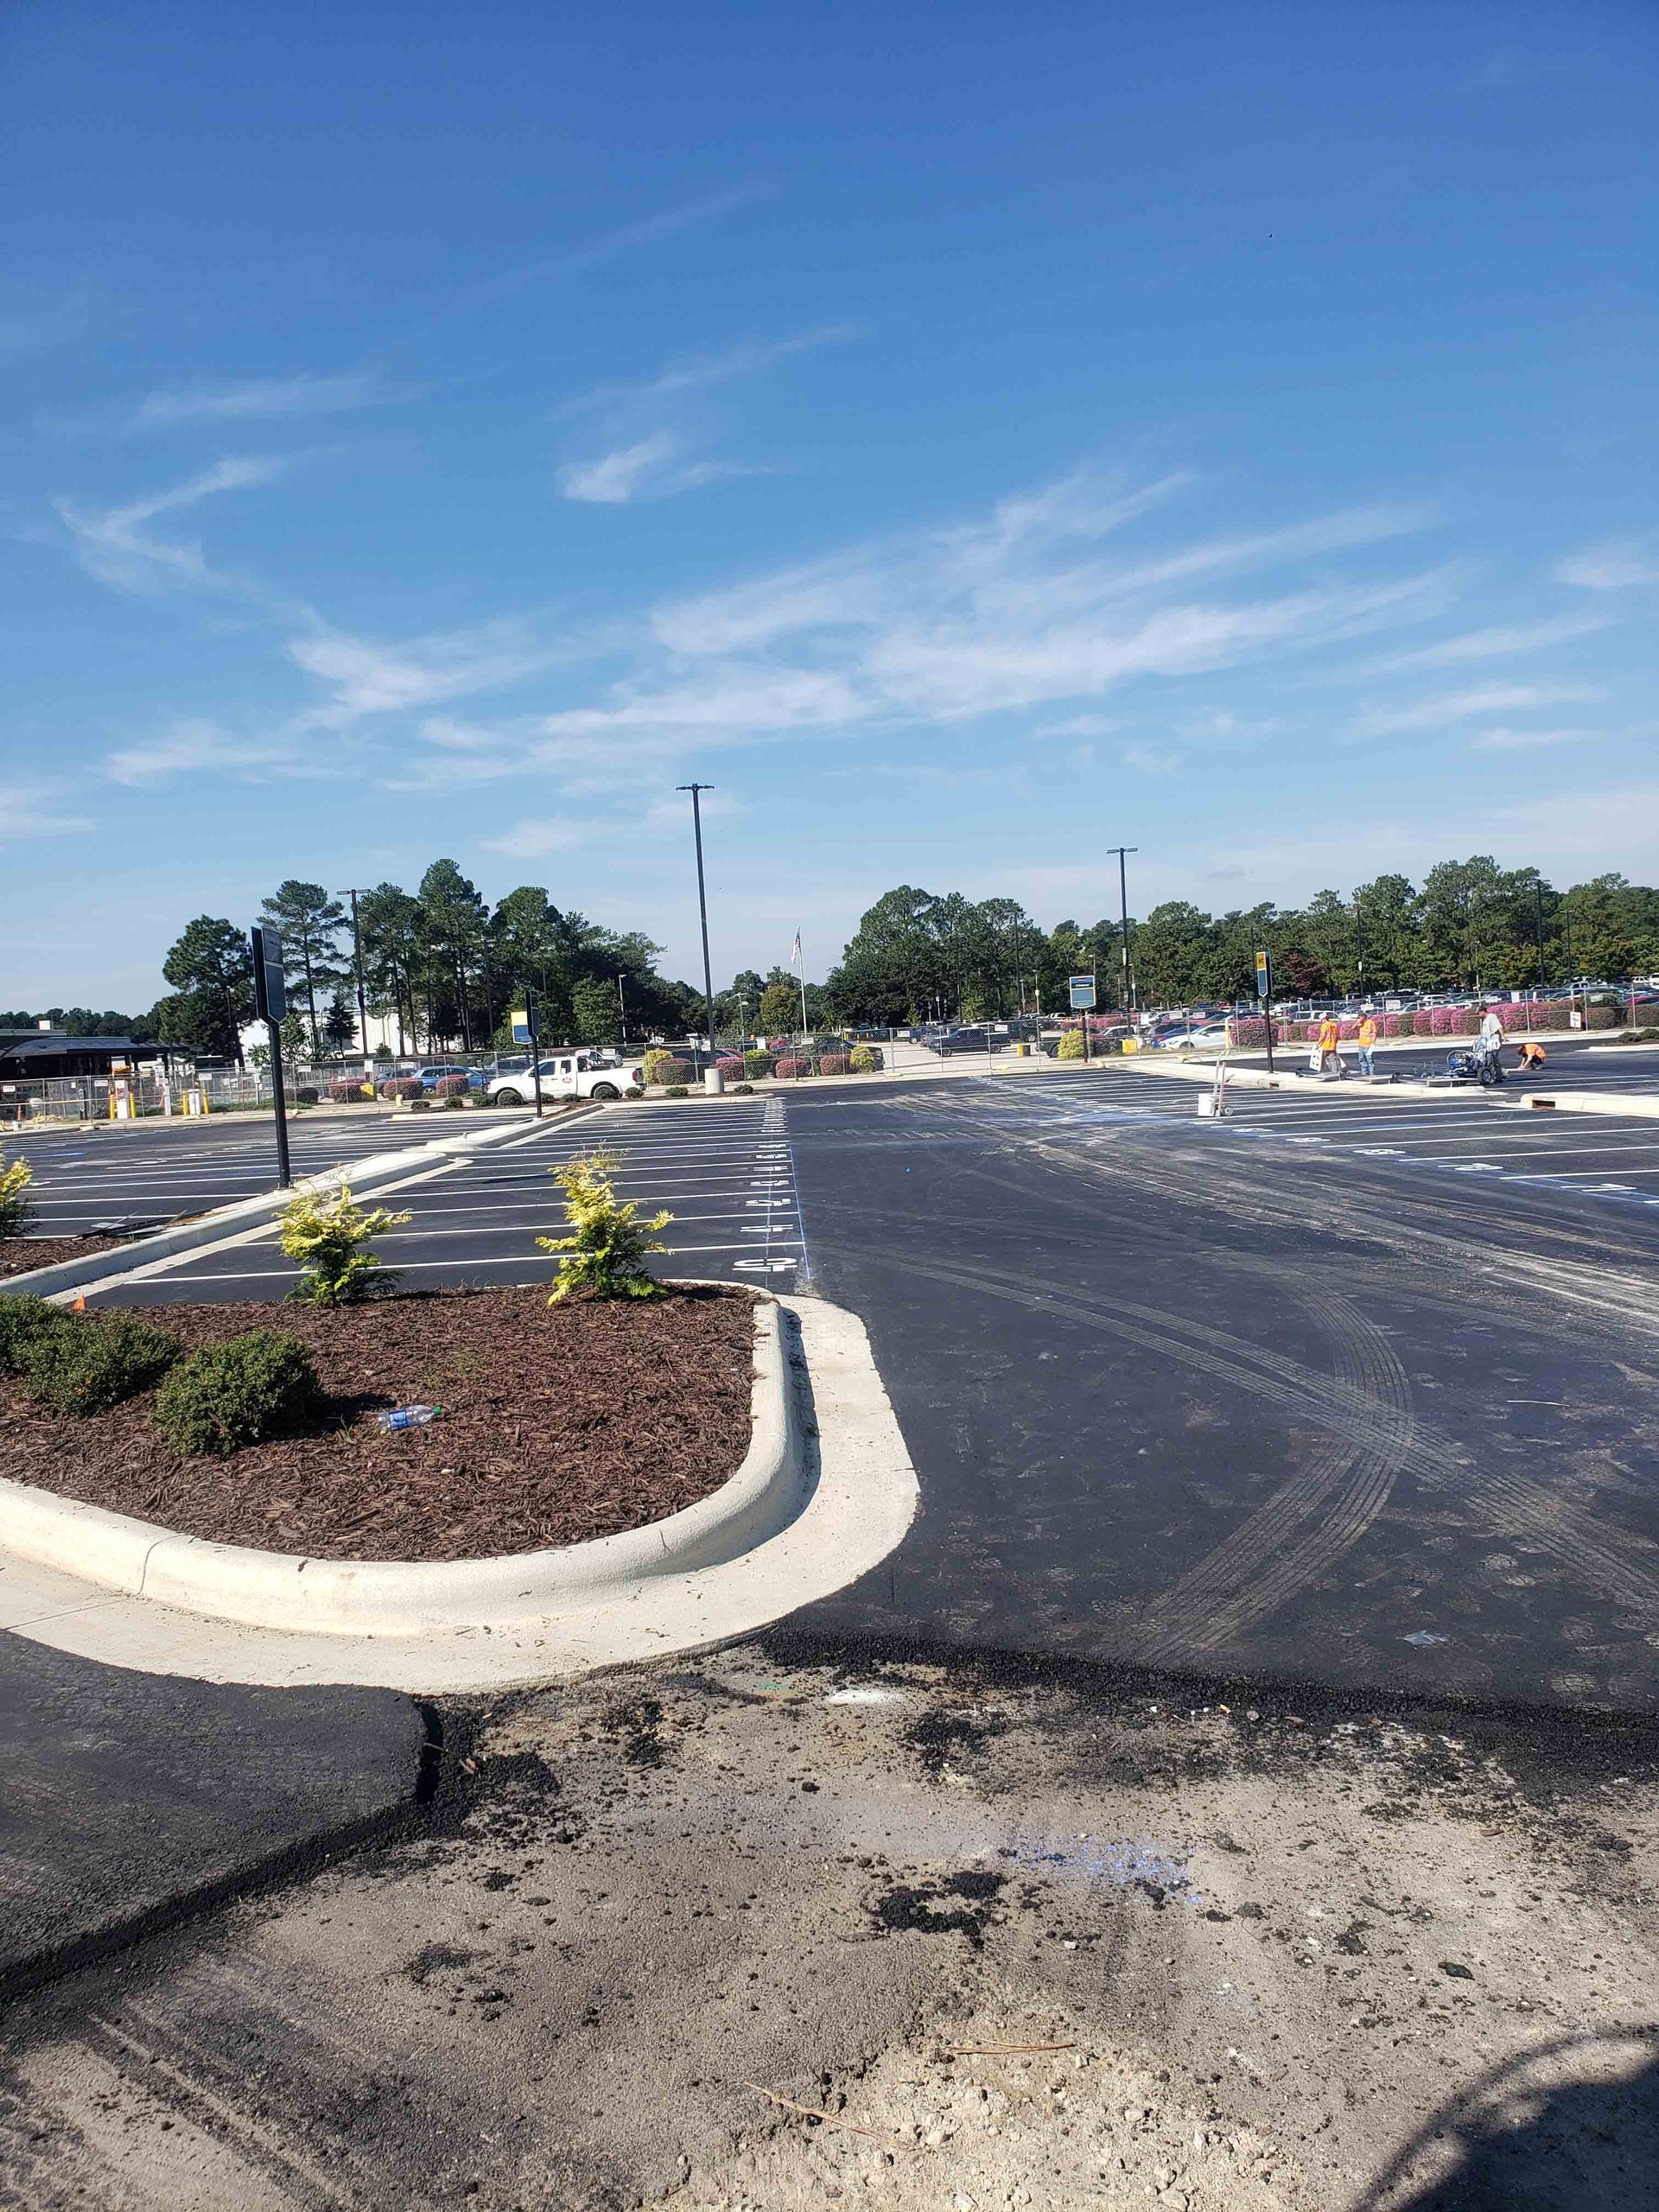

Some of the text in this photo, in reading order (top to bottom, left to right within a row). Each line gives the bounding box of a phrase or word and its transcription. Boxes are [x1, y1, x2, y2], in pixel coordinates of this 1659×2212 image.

[1437, 1163, 1503, 1172] 70
[1560, 1183, 1637, 1192] 71
[740, 1224, 793, 1232] 41
[733, 1257, 798, 1272] 40
